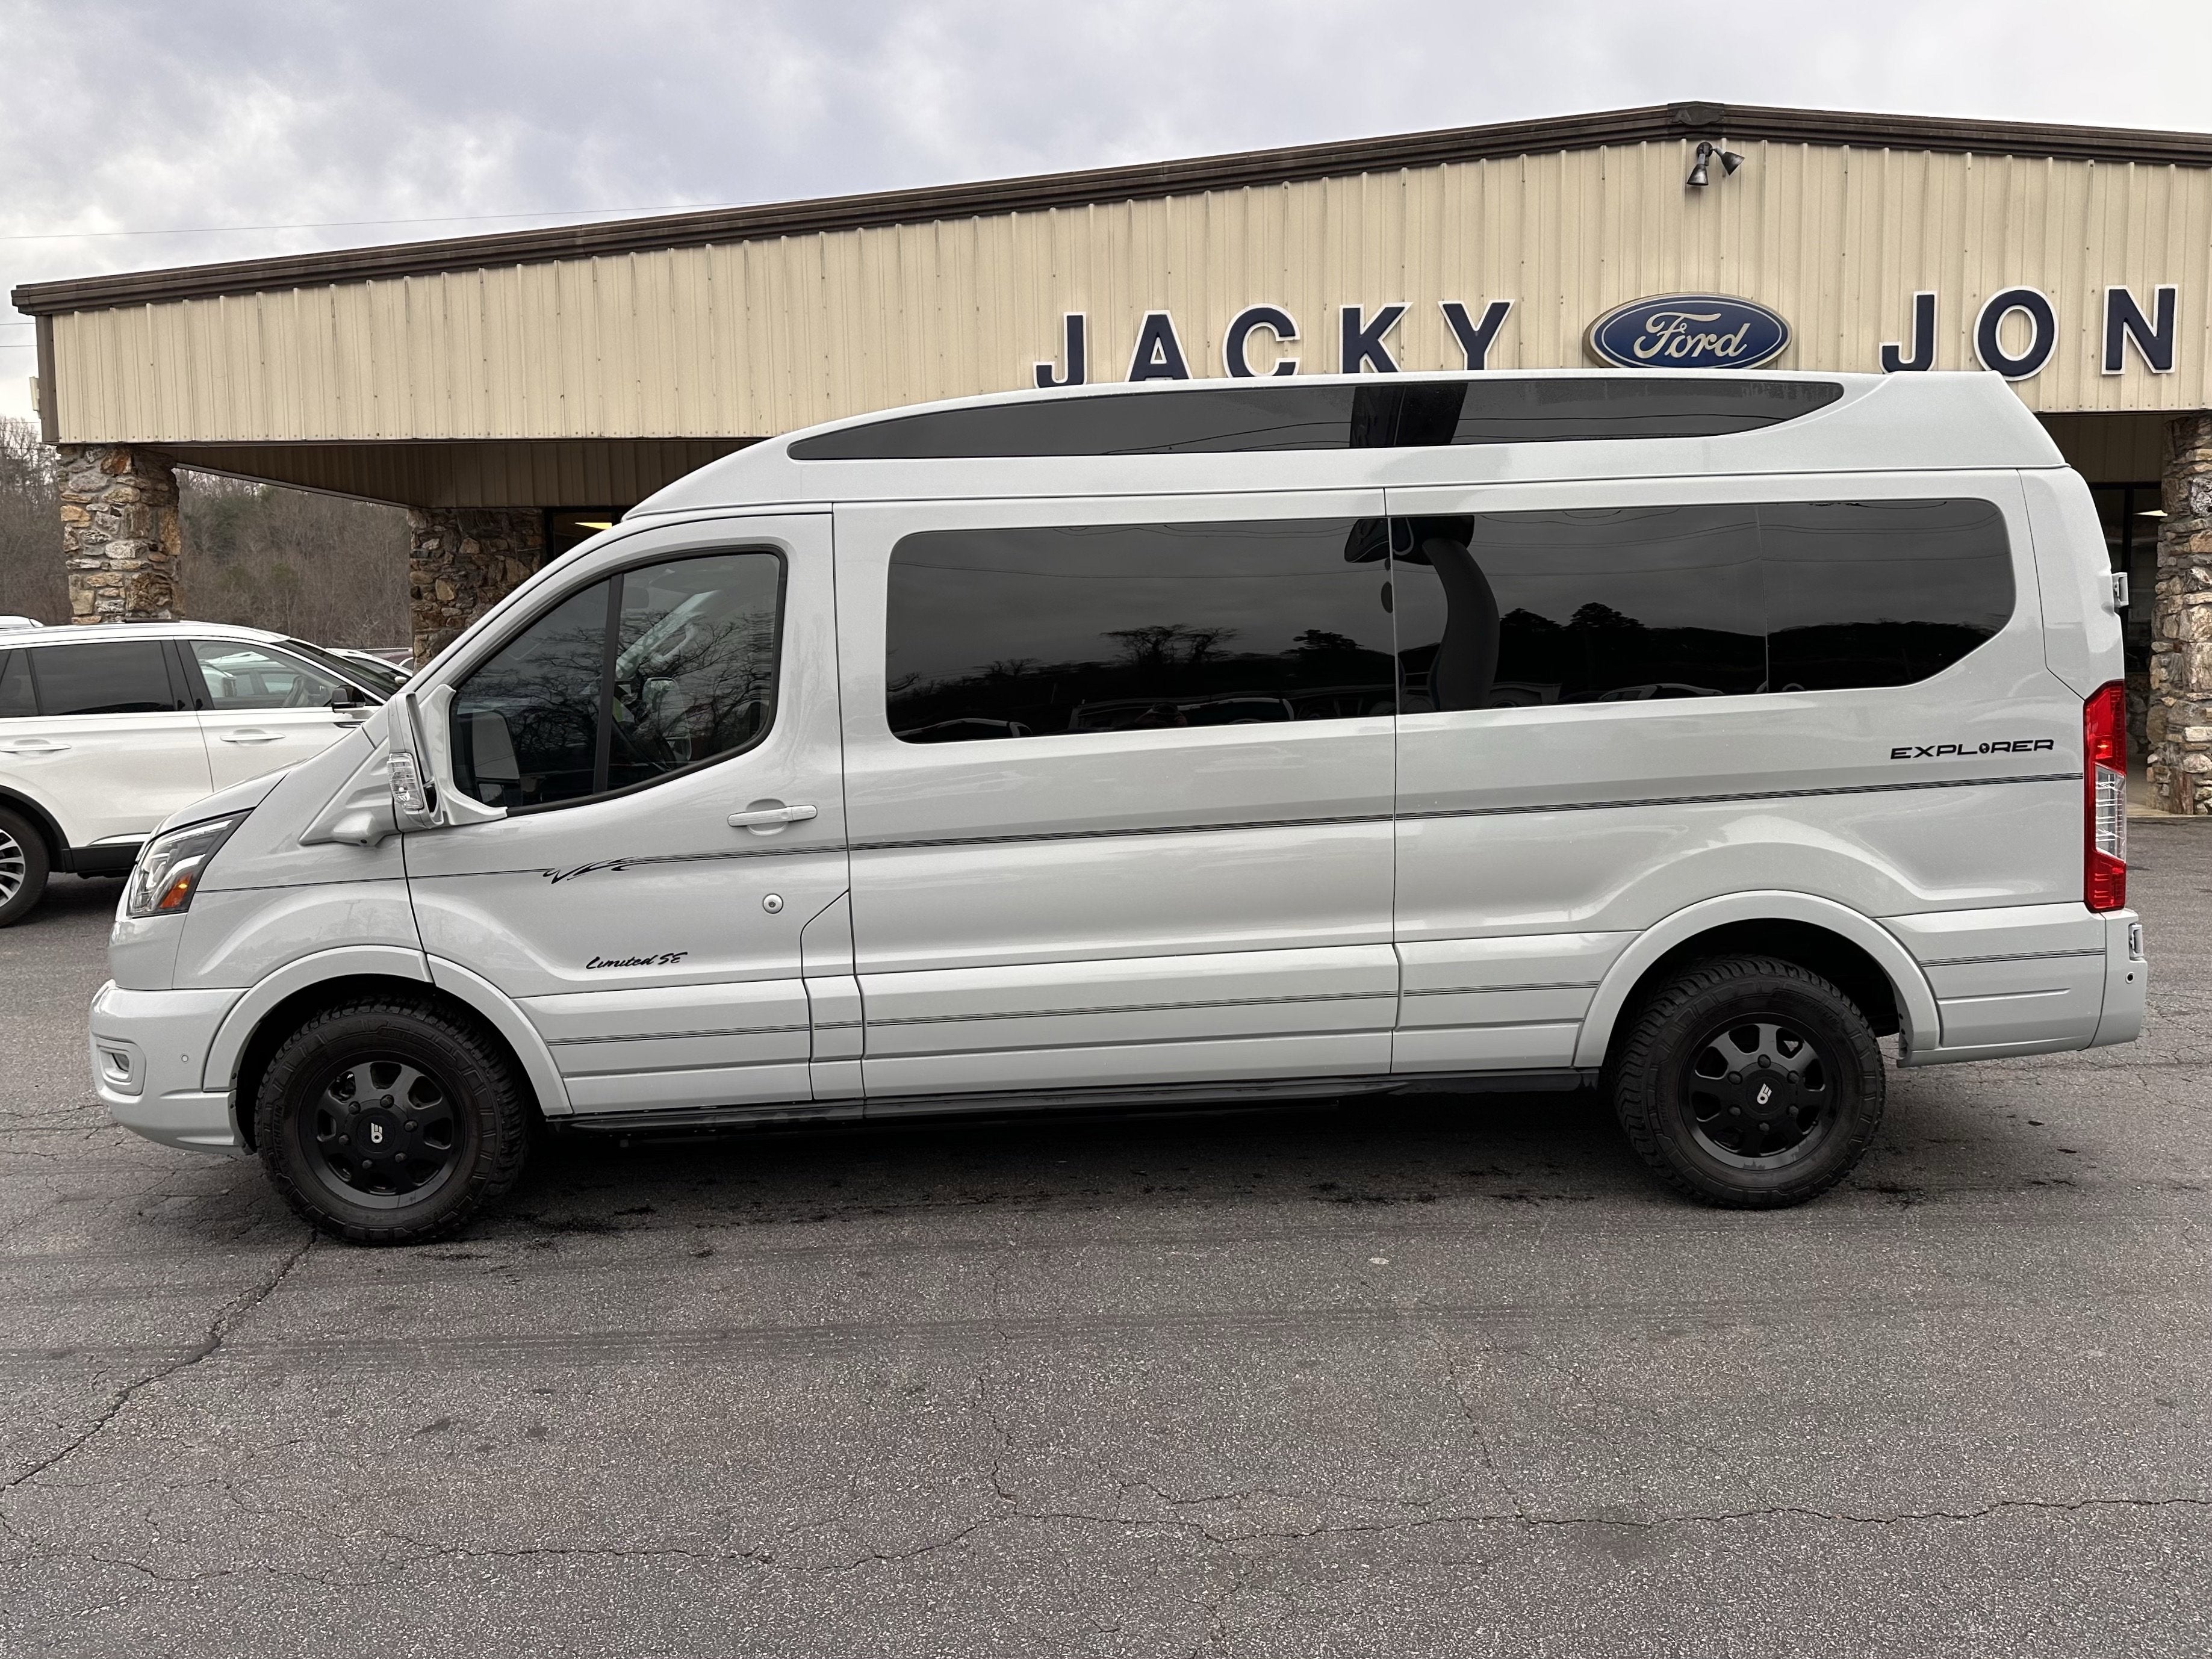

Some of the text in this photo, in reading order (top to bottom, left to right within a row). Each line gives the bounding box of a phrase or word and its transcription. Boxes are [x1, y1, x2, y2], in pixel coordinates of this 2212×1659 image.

[1033, 284, 2179, 388] JACKY JON
[1633, 312, 1751, 359] Ford
[1890, 739, 2055, 760] EXPLORER
[585, 951, 688, 969] Limited SE
[273, 1104, 286, 1161] MICHELIN
